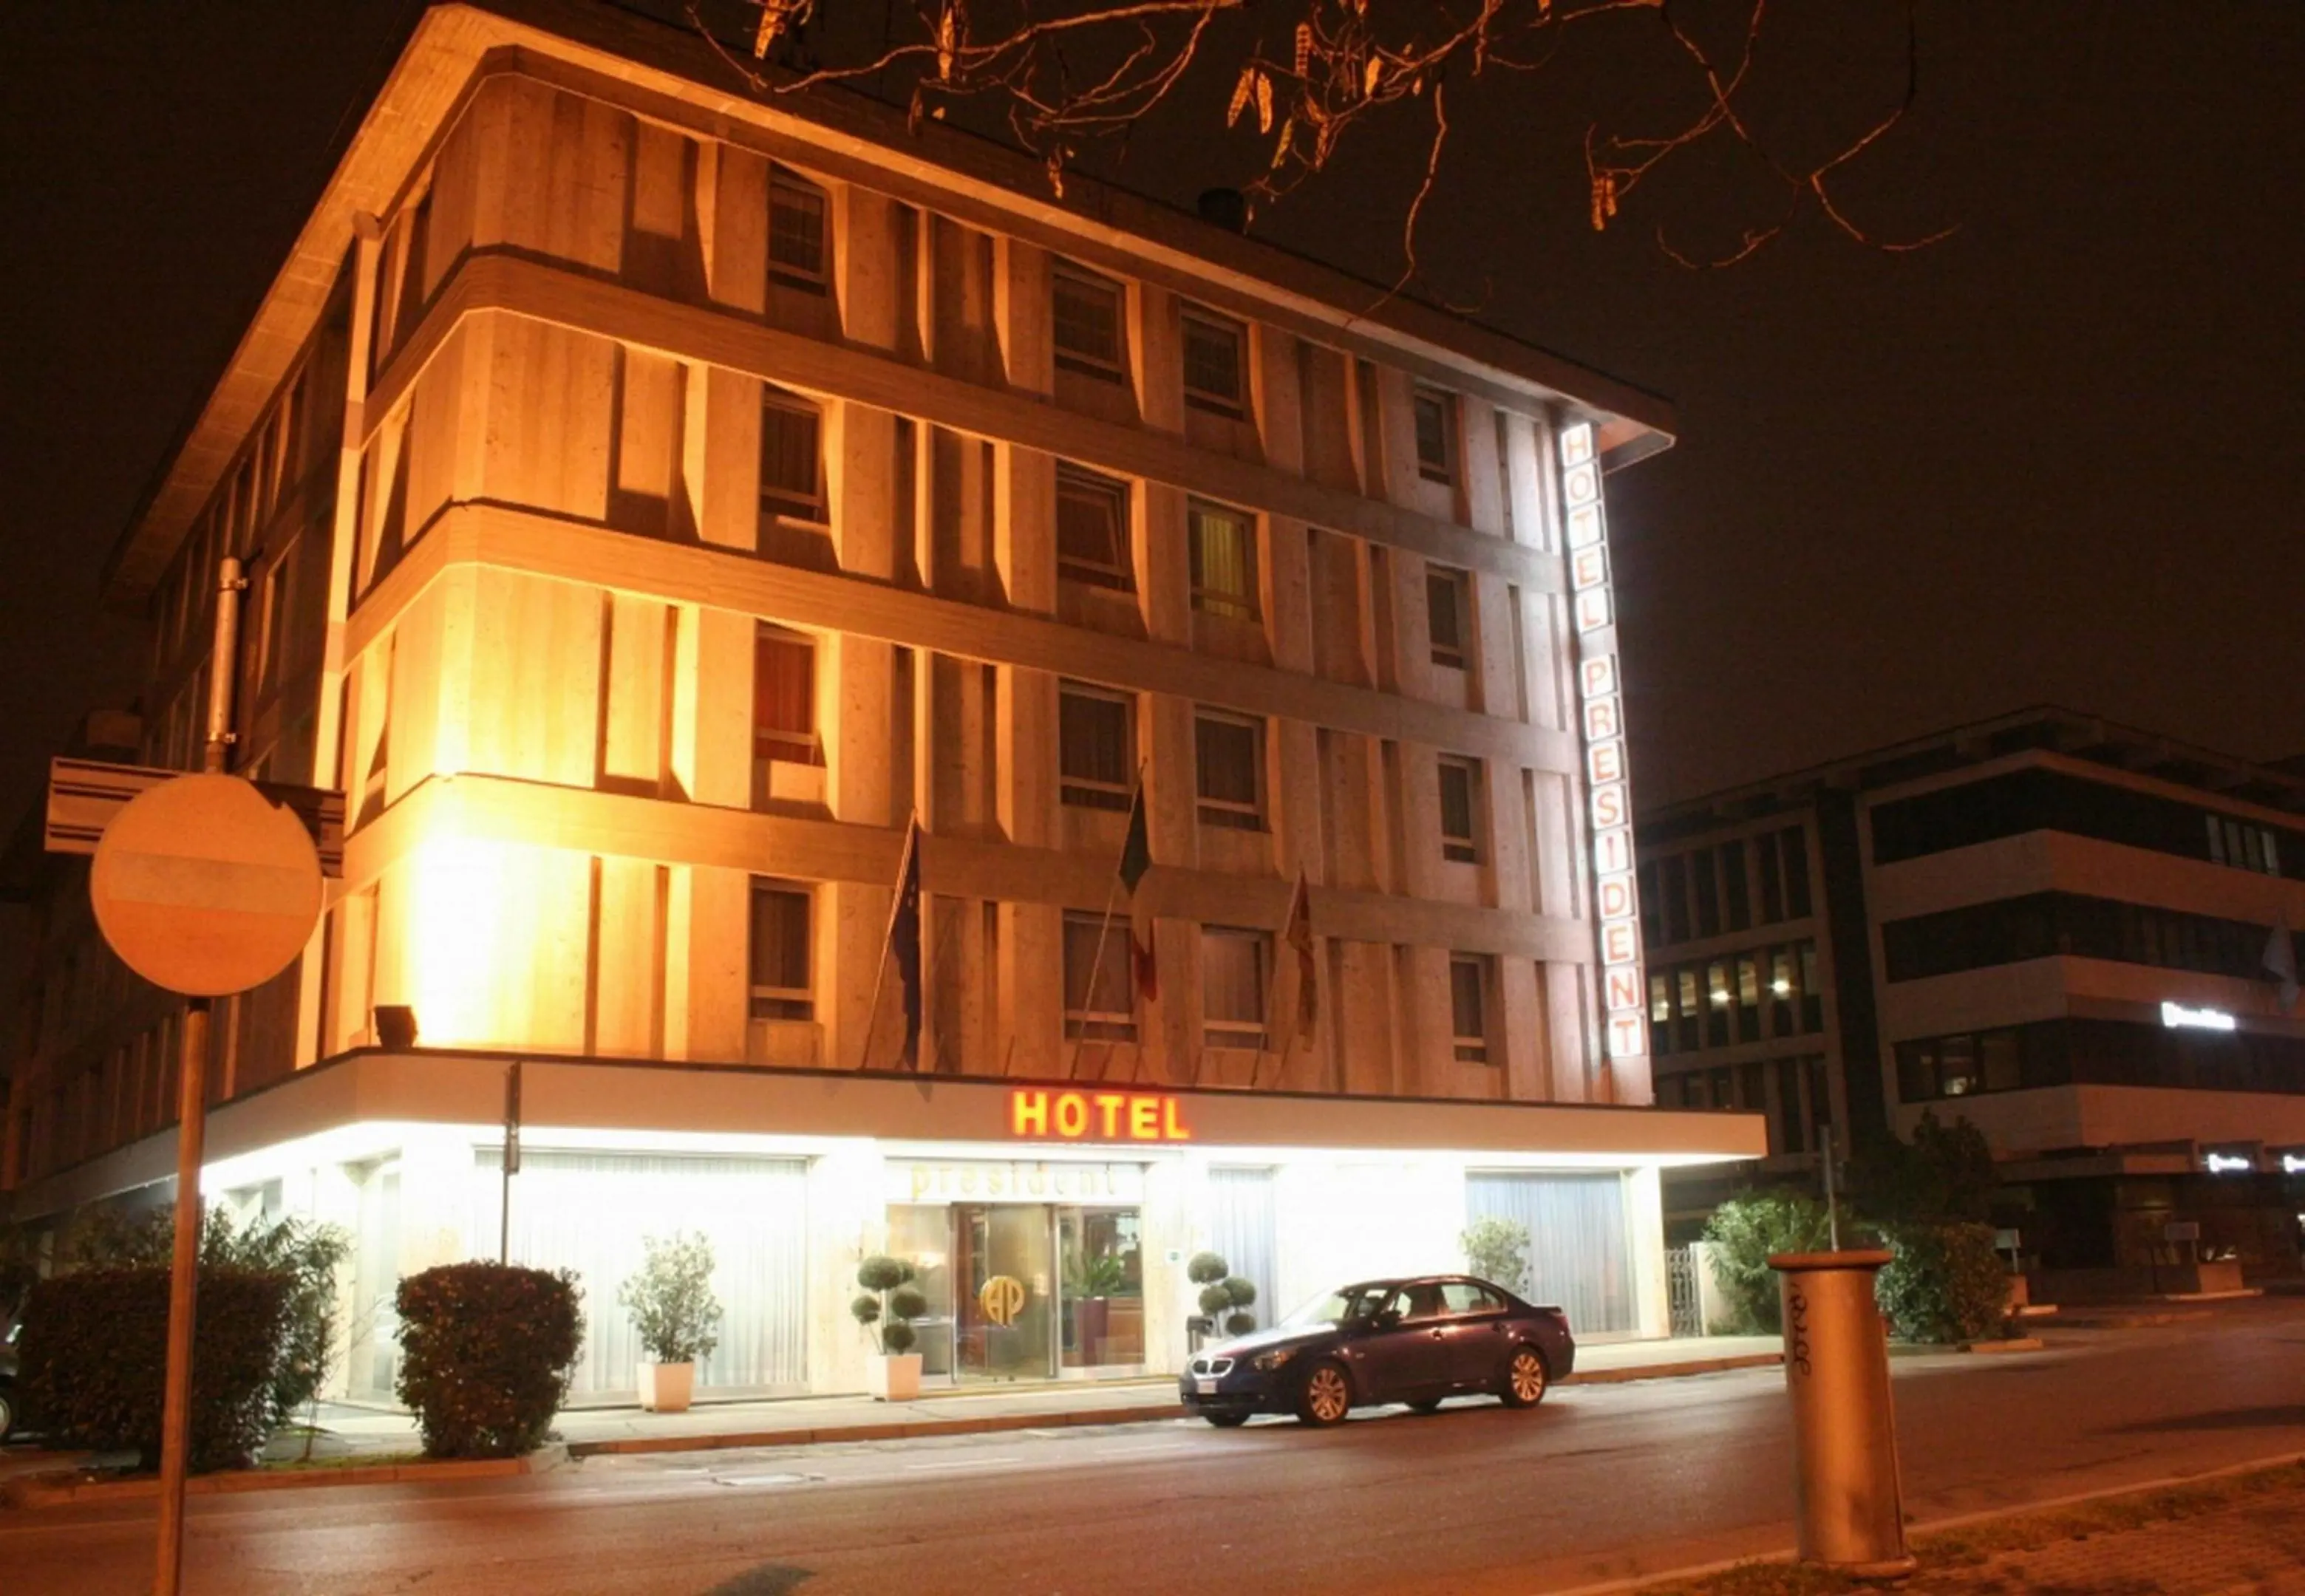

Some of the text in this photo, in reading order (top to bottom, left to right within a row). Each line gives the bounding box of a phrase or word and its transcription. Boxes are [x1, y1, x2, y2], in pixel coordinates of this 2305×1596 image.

[1563, 426, 1640, 1054] HOTEL PRESIDENT
[1013, 1090, 1191, 1140] HOTEL
[911, 1161, 1115, 1202] president
